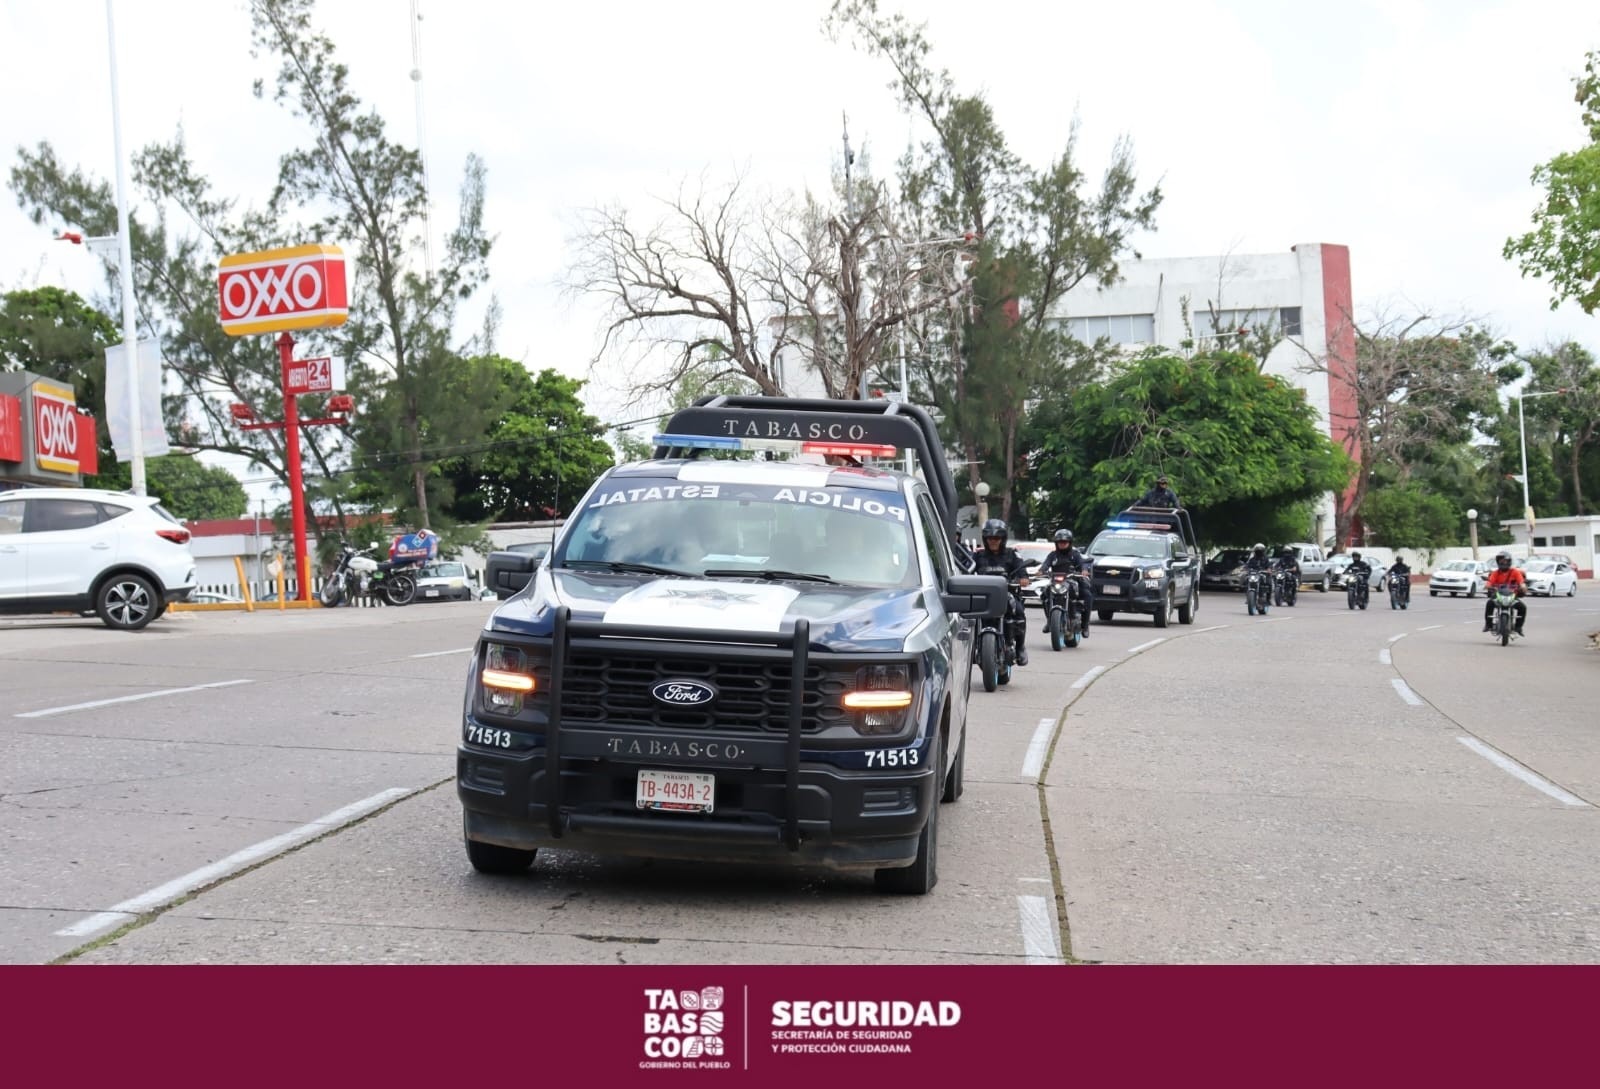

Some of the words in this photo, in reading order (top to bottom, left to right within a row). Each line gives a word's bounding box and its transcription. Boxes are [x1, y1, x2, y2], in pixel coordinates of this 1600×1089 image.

[223, 264, 322, 317] OXXO
[309, 361, 329, 381] 24
[40, 403, 77, 456] OXXO
[664, 685, 702, 702] Ford
[468, 725, 511, 748] 71513
[864, 749, 919, 767] 71513
[640, 780, 711, 801] TB-443A-2
